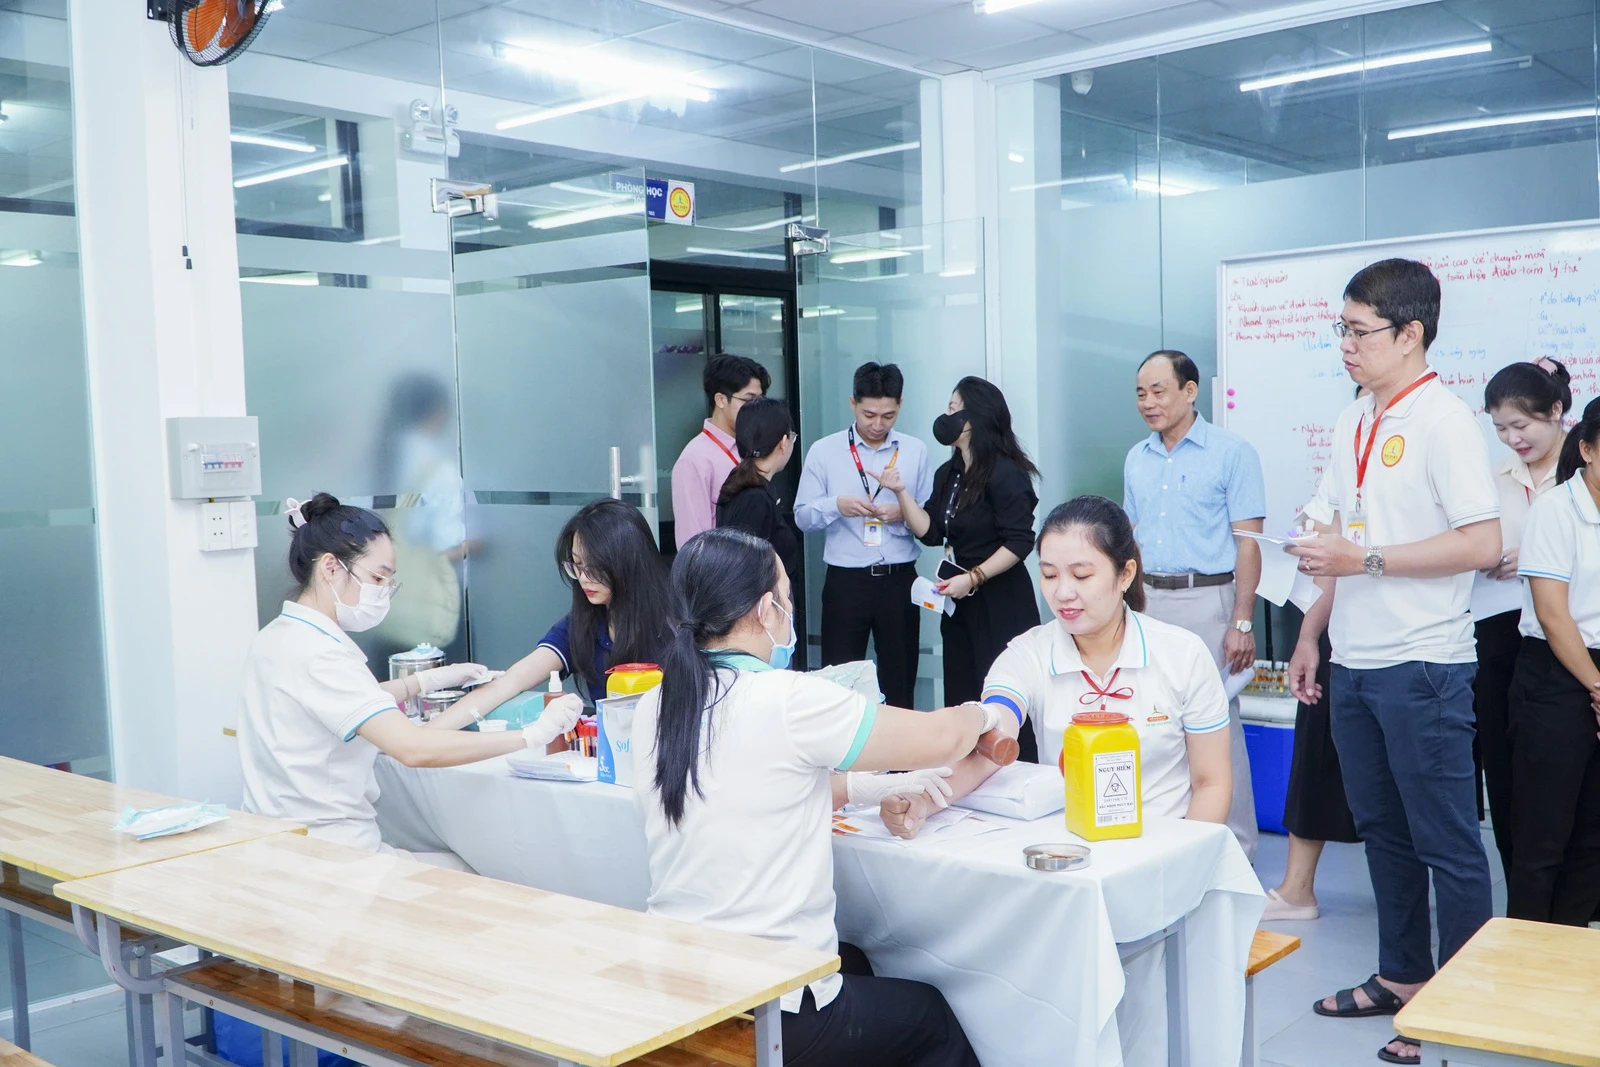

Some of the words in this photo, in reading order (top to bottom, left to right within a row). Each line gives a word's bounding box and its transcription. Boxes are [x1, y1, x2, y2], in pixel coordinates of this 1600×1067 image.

[616, 181, 645, 194] PHÒNG
[646, 187, 663, 199] HỌC
[1098, 766, 1115, 774] NGUY
[1116, 762, 1131, 771] HIỂM
